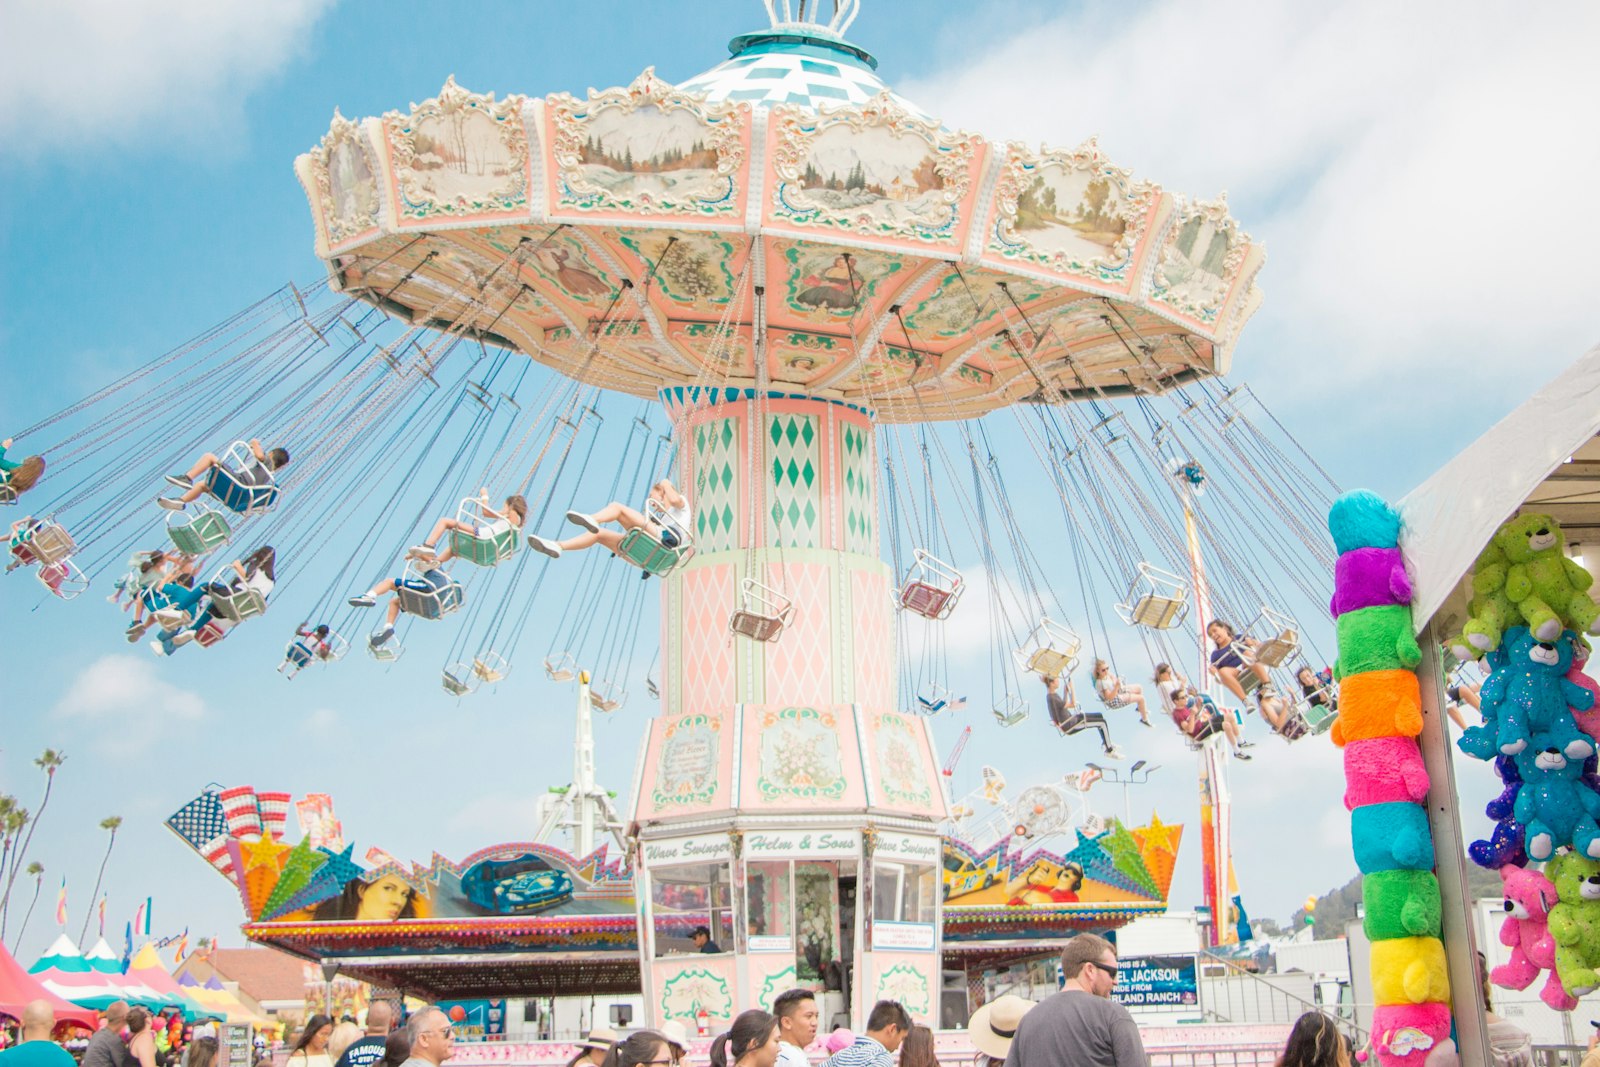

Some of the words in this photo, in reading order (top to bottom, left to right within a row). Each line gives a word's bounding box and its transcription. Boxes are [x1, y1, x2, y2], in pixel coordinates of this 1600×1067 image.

[748, 835, 793, 851] Helm
[798, 834, 812, 850] &
[817, 834, 855, 850] Sons
[876, 837, 897, 852] Wave
[900, 838, 936, 859] Swinger
[646, 844, 678, 860] Wave
[682, 840, 730, 858] Swinger
[1132, 960, 1140, 968] IS
[1141, 960, 1147, 968] A
[1131, 969, 1179, 982] JACKSON
[1113, 984, 1130, 993] RIDE
[1131, 984, 1152, 992] FROM
[1109, 993, 1144, 1004] RLAND
[1146, 992, 1181, 1003] RANCH
[349, 1045, 386, 1060] FAMOUS
